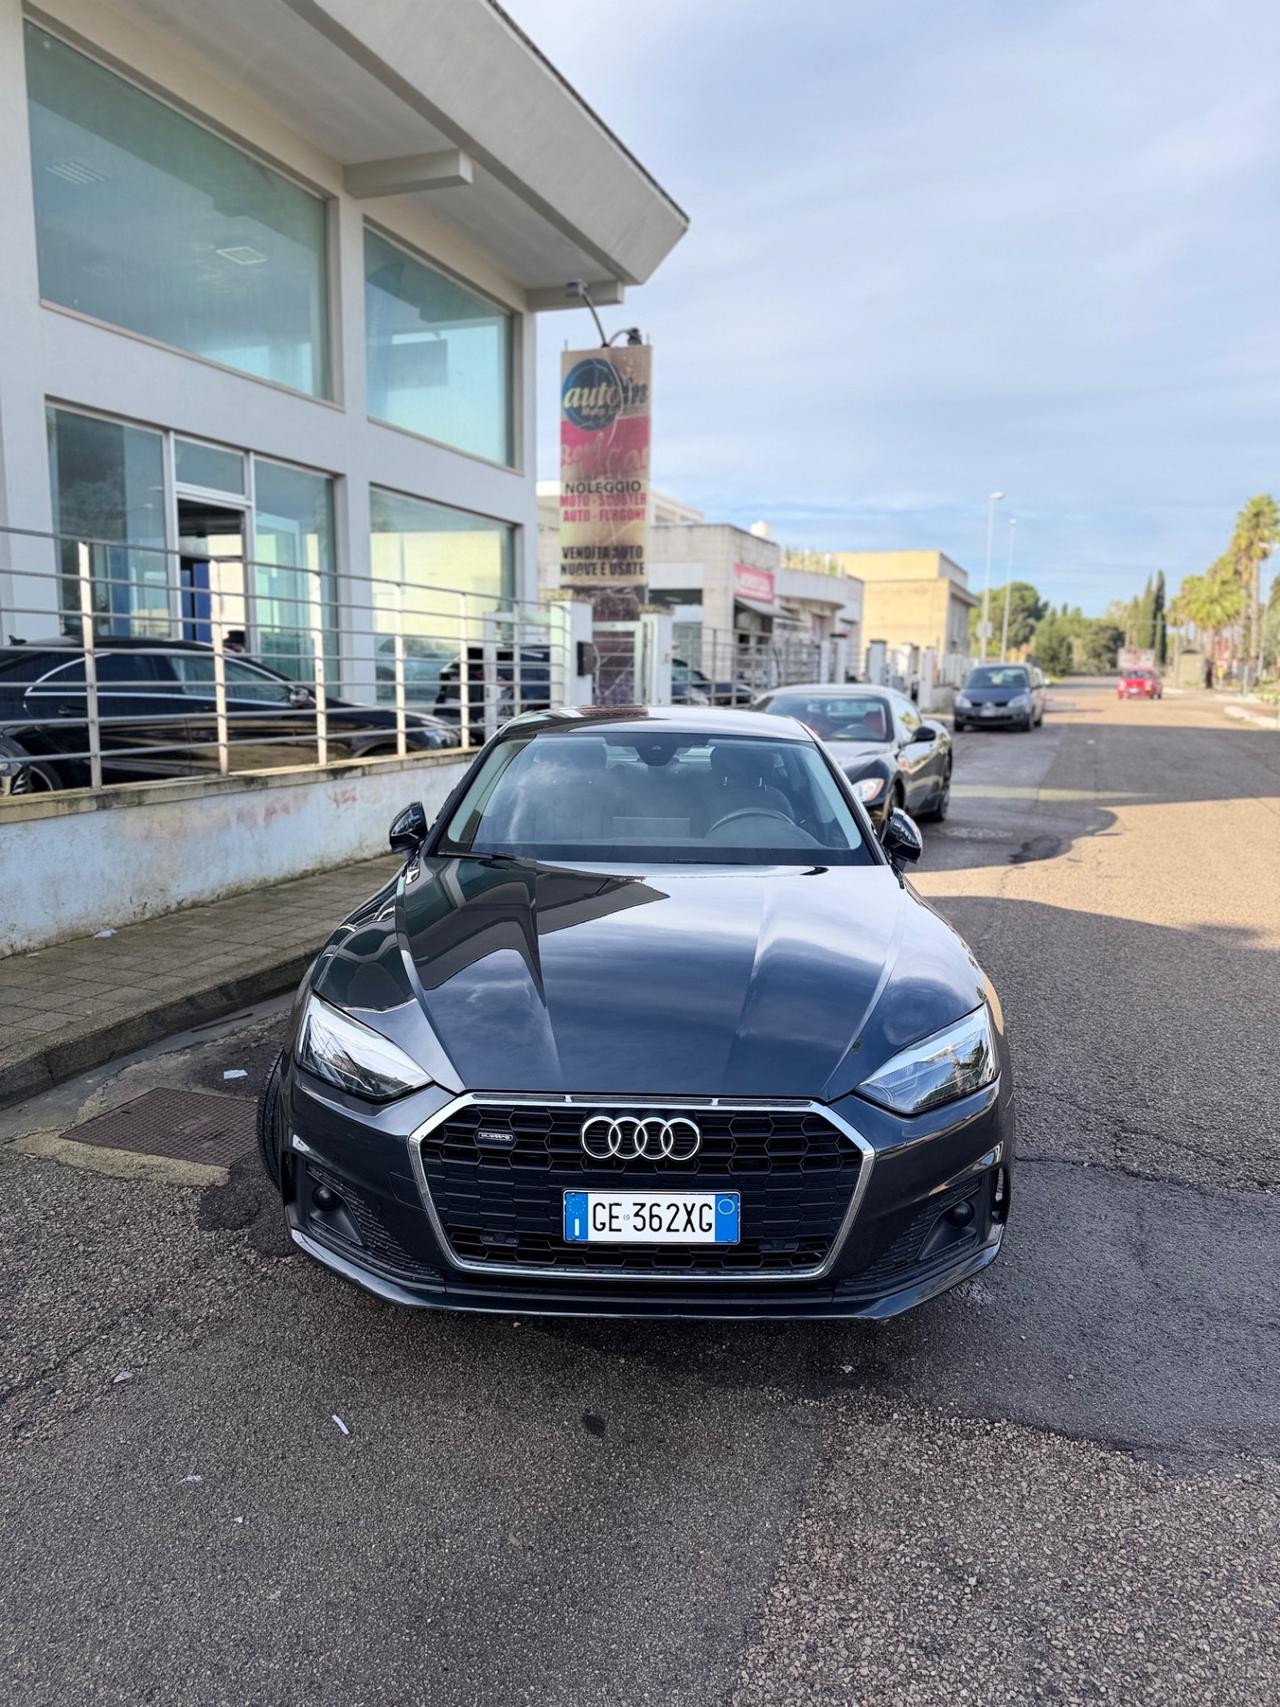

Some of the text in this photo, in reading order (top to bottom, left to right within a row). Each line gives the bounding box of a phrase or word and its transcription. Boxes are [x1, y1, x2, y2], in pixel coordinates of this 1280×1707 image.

[565, 481, 642, 494] NOLEGGIO
[560, 494, 590, 508] MOTO
[598, 492, 647, 507] SCOOTER
[563, 510, 591, 522] AUTO
[599, 508, 646, 522] FURGONI
[562, 544, 644, 560] VENDITA AUTO
[560, 561, 645, 576] NUOVE E USATE
[592, 1202, 622, 1233] GE
[632, 1203, 713, 1233] 362XG
